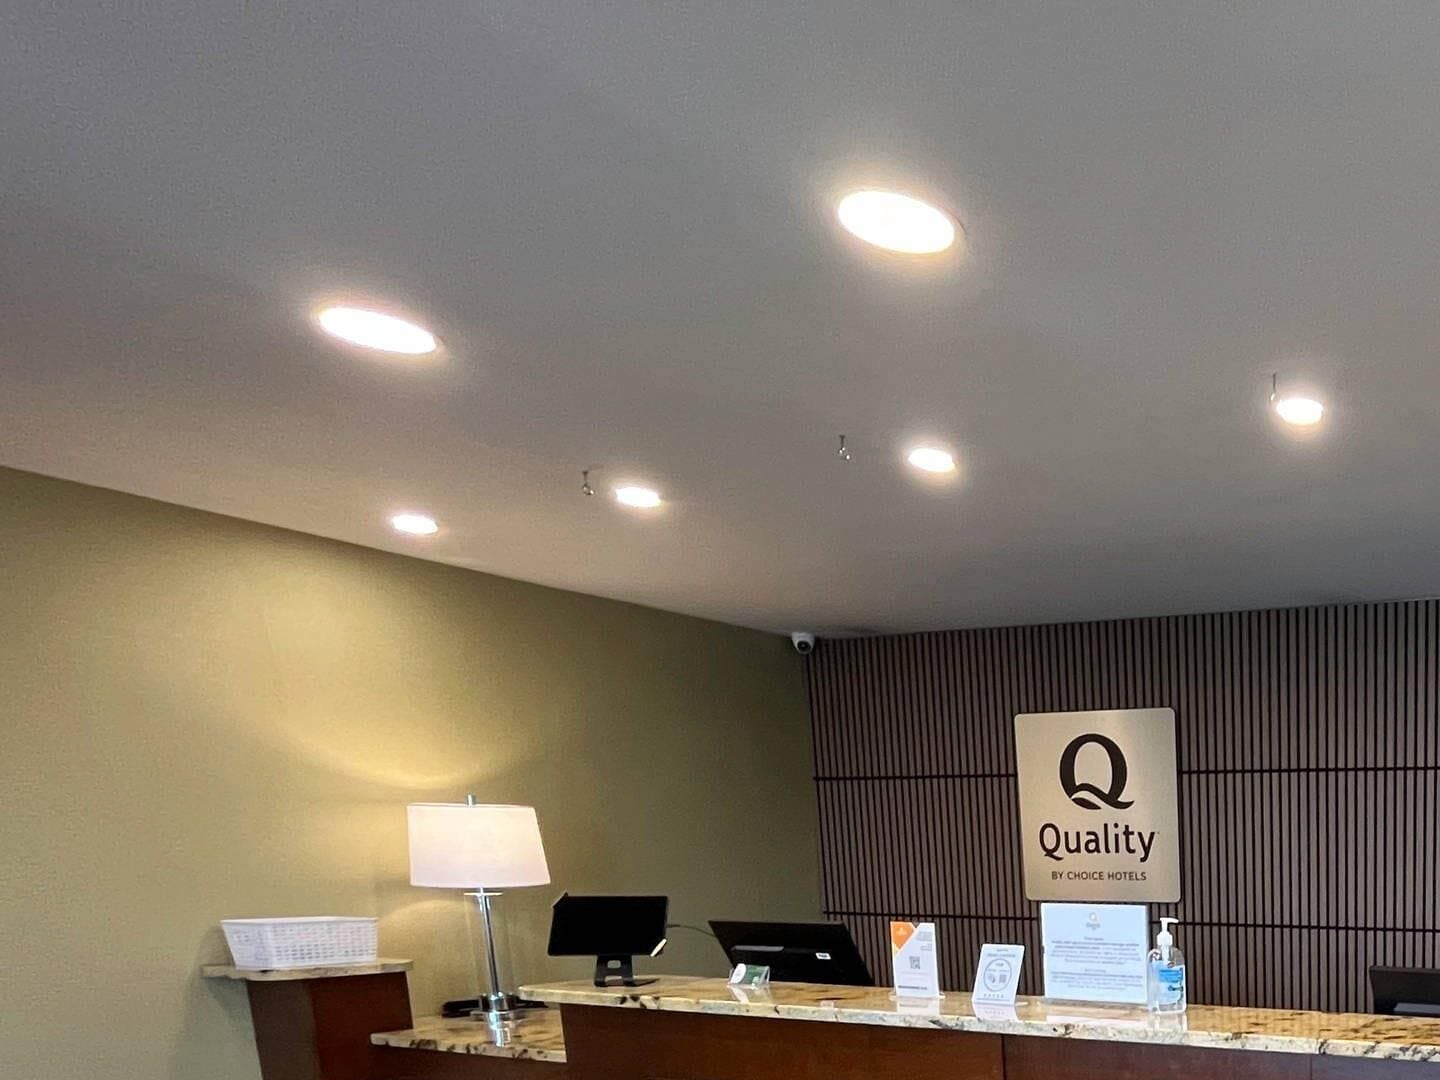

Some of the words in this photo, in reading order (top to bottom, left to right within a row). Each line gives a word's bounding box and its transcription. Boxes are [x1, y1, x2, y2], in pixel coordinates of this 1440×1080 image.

[1051, 871, 1064, 880] BY
[1067, 871, 1104, 880] CHOICE
[1107, 871, 1147, 881] HOTELS
